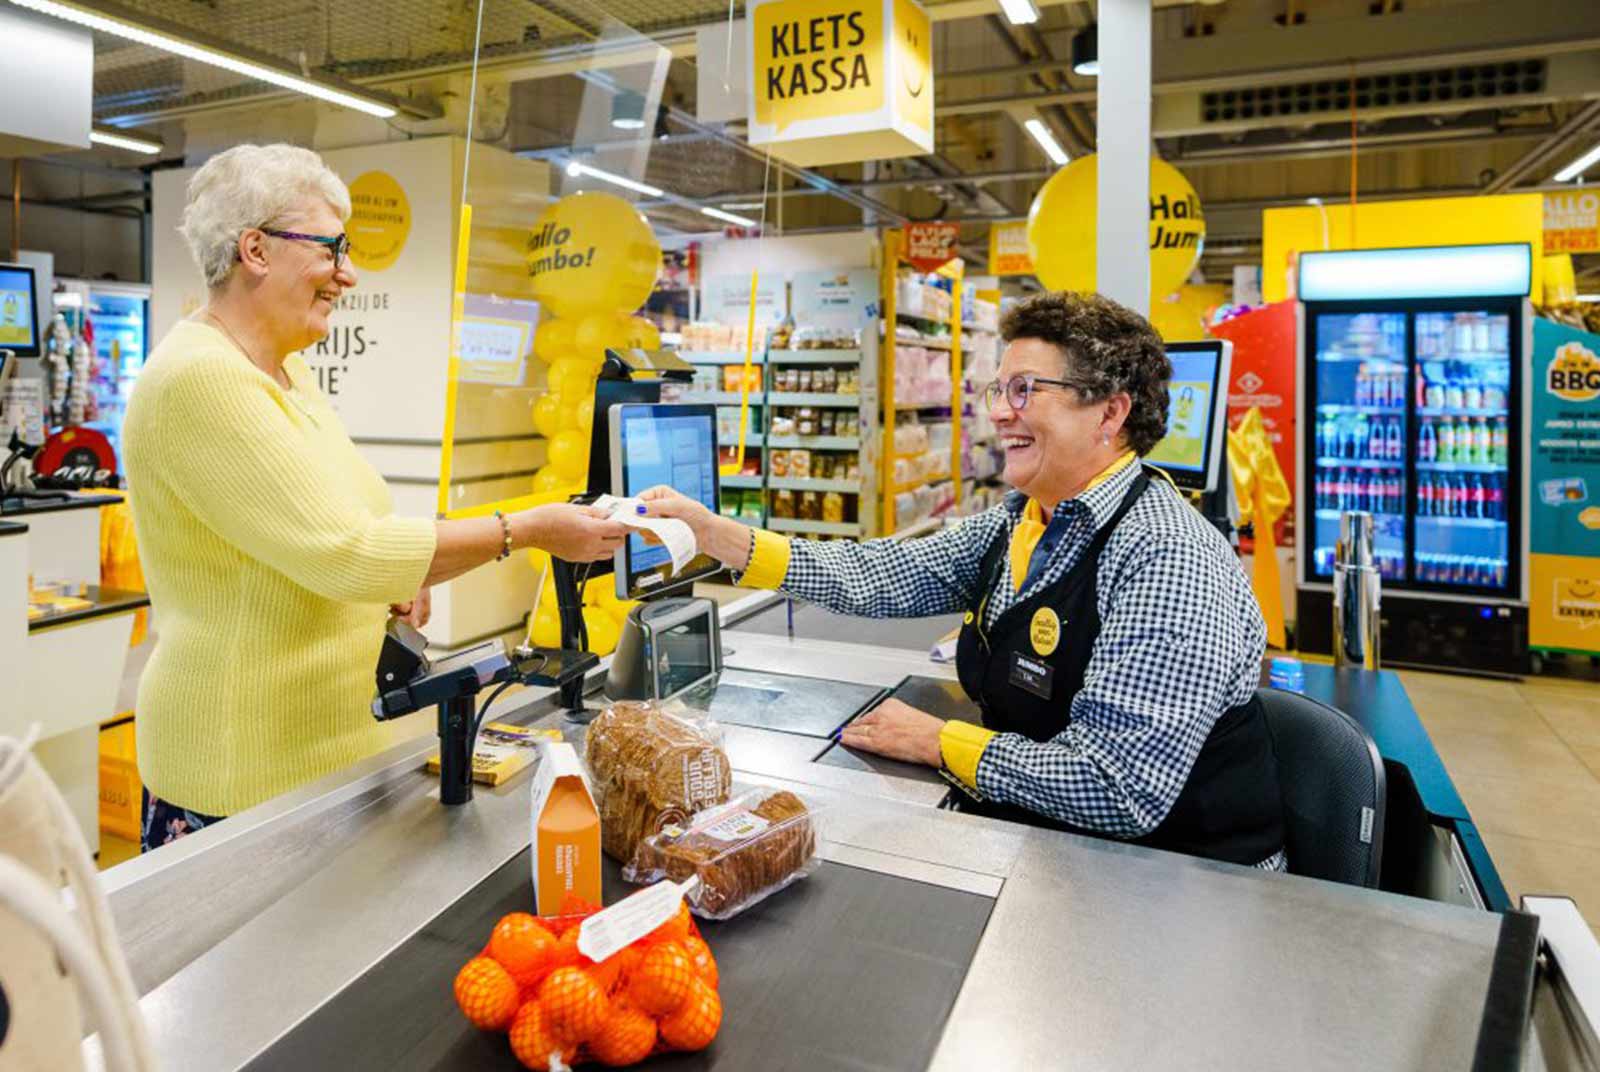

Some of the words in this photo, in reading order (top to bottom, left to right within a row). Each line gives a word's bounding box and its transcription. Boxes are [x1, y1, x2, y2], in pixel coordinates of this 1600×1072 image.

[771, 11, 865, 59] KLETS
[767, 53, 871, 101] KASSA
[372, 292, 389, 309] DE
[300, 325, 378, 360] RIJS-
[688, 760, 705, 802] GOUD
